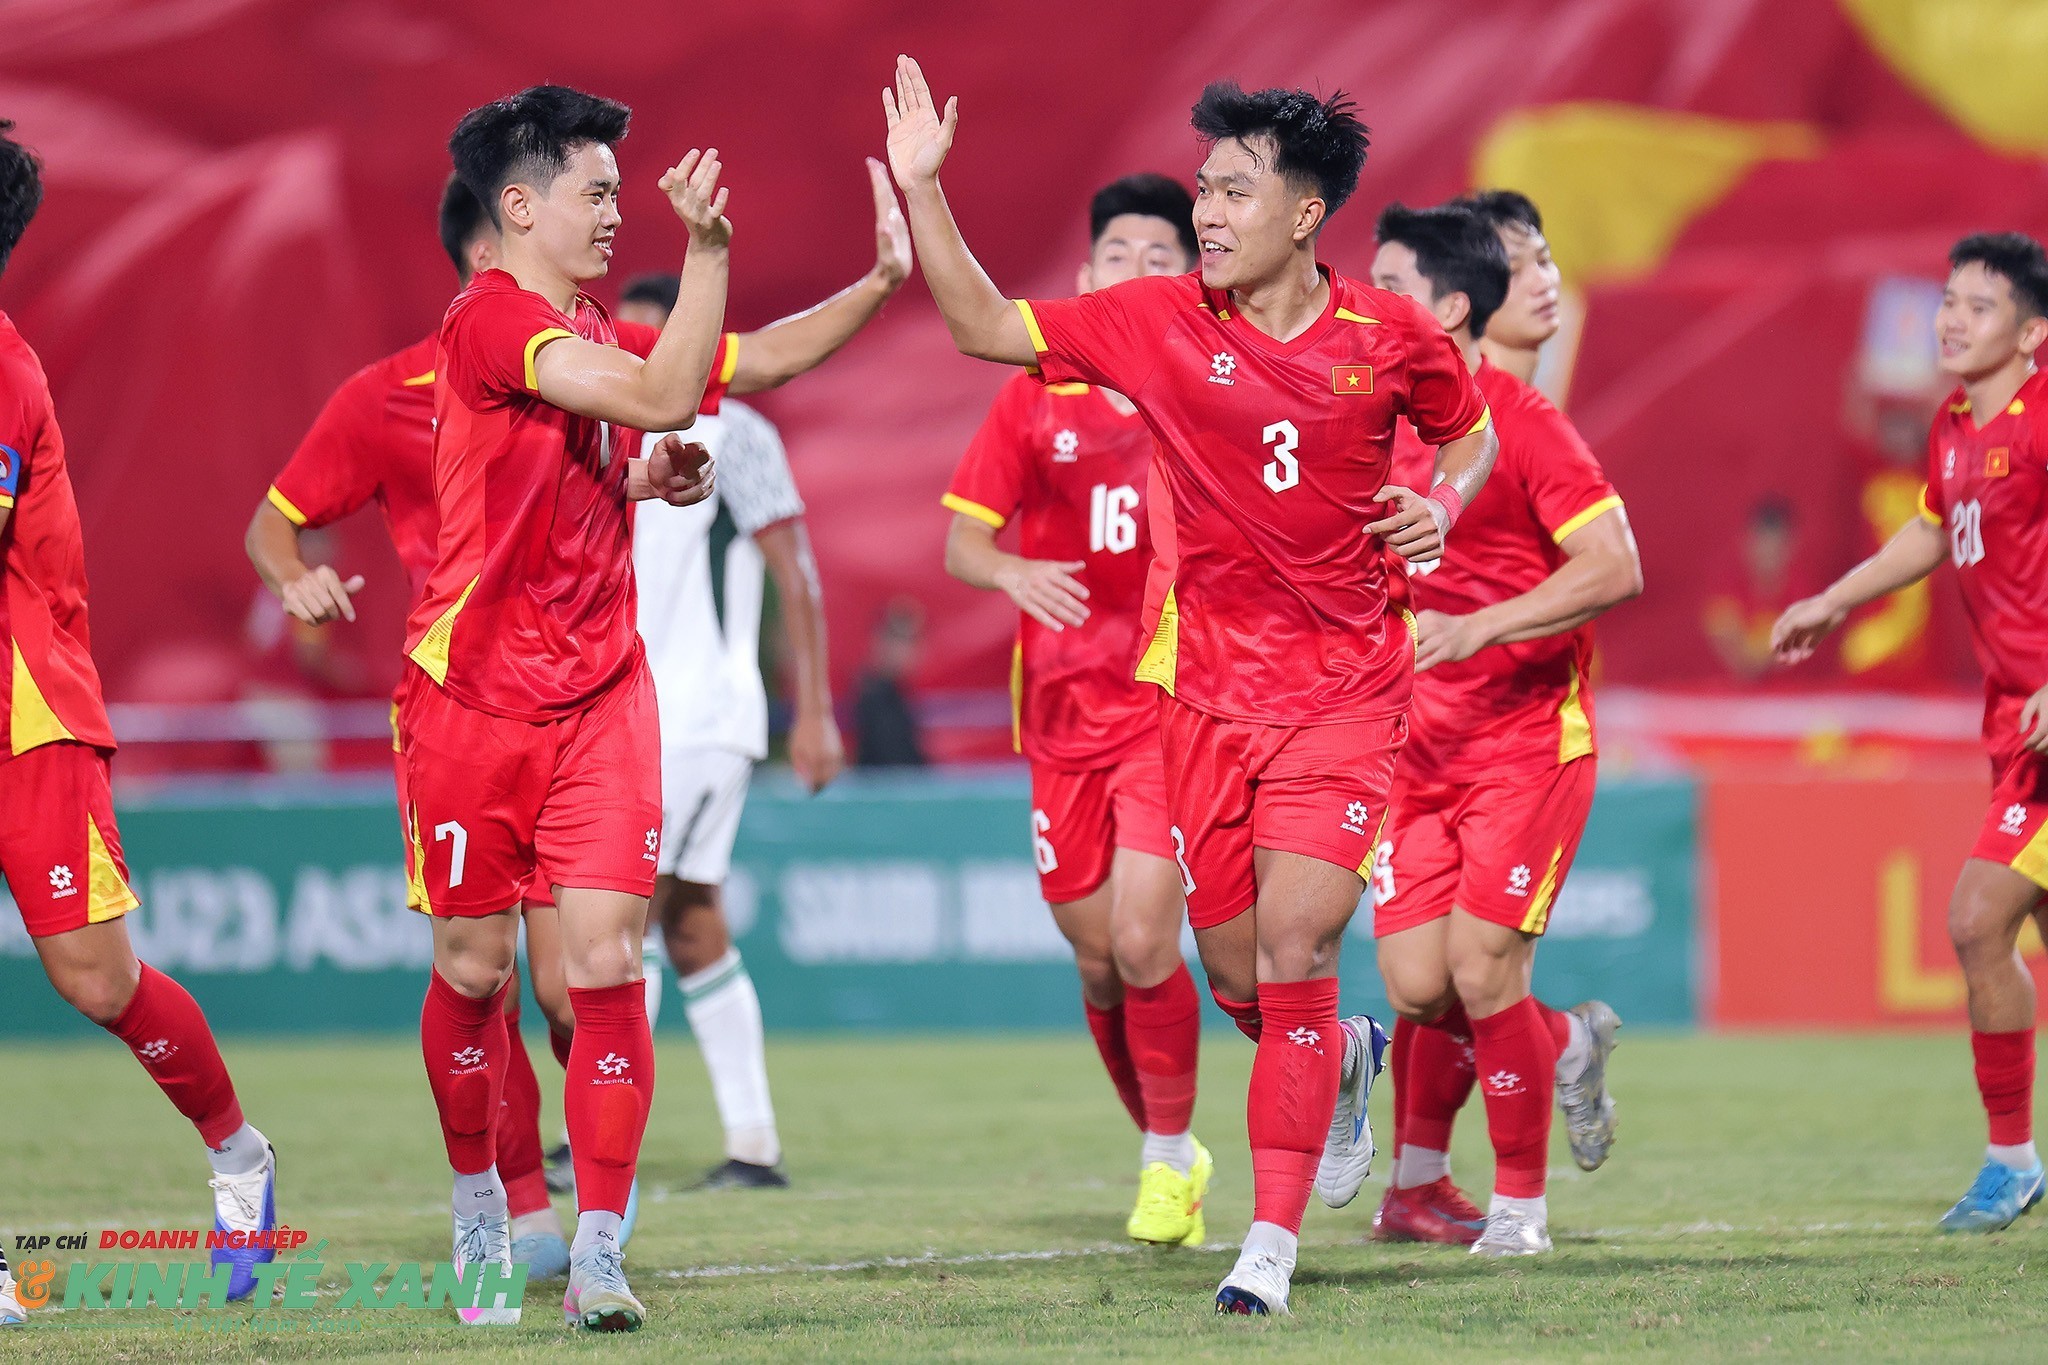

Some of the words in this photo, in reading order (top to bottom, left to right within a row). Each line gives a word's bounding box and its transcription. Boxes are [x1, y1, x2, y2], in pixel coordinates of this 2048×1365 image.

[1262, 419, 1300, 493] 3
[1089, 484, 1139, 554] 16
[1952, 499, 1985, 568] 20
[434, 820, 468, 889] 7
